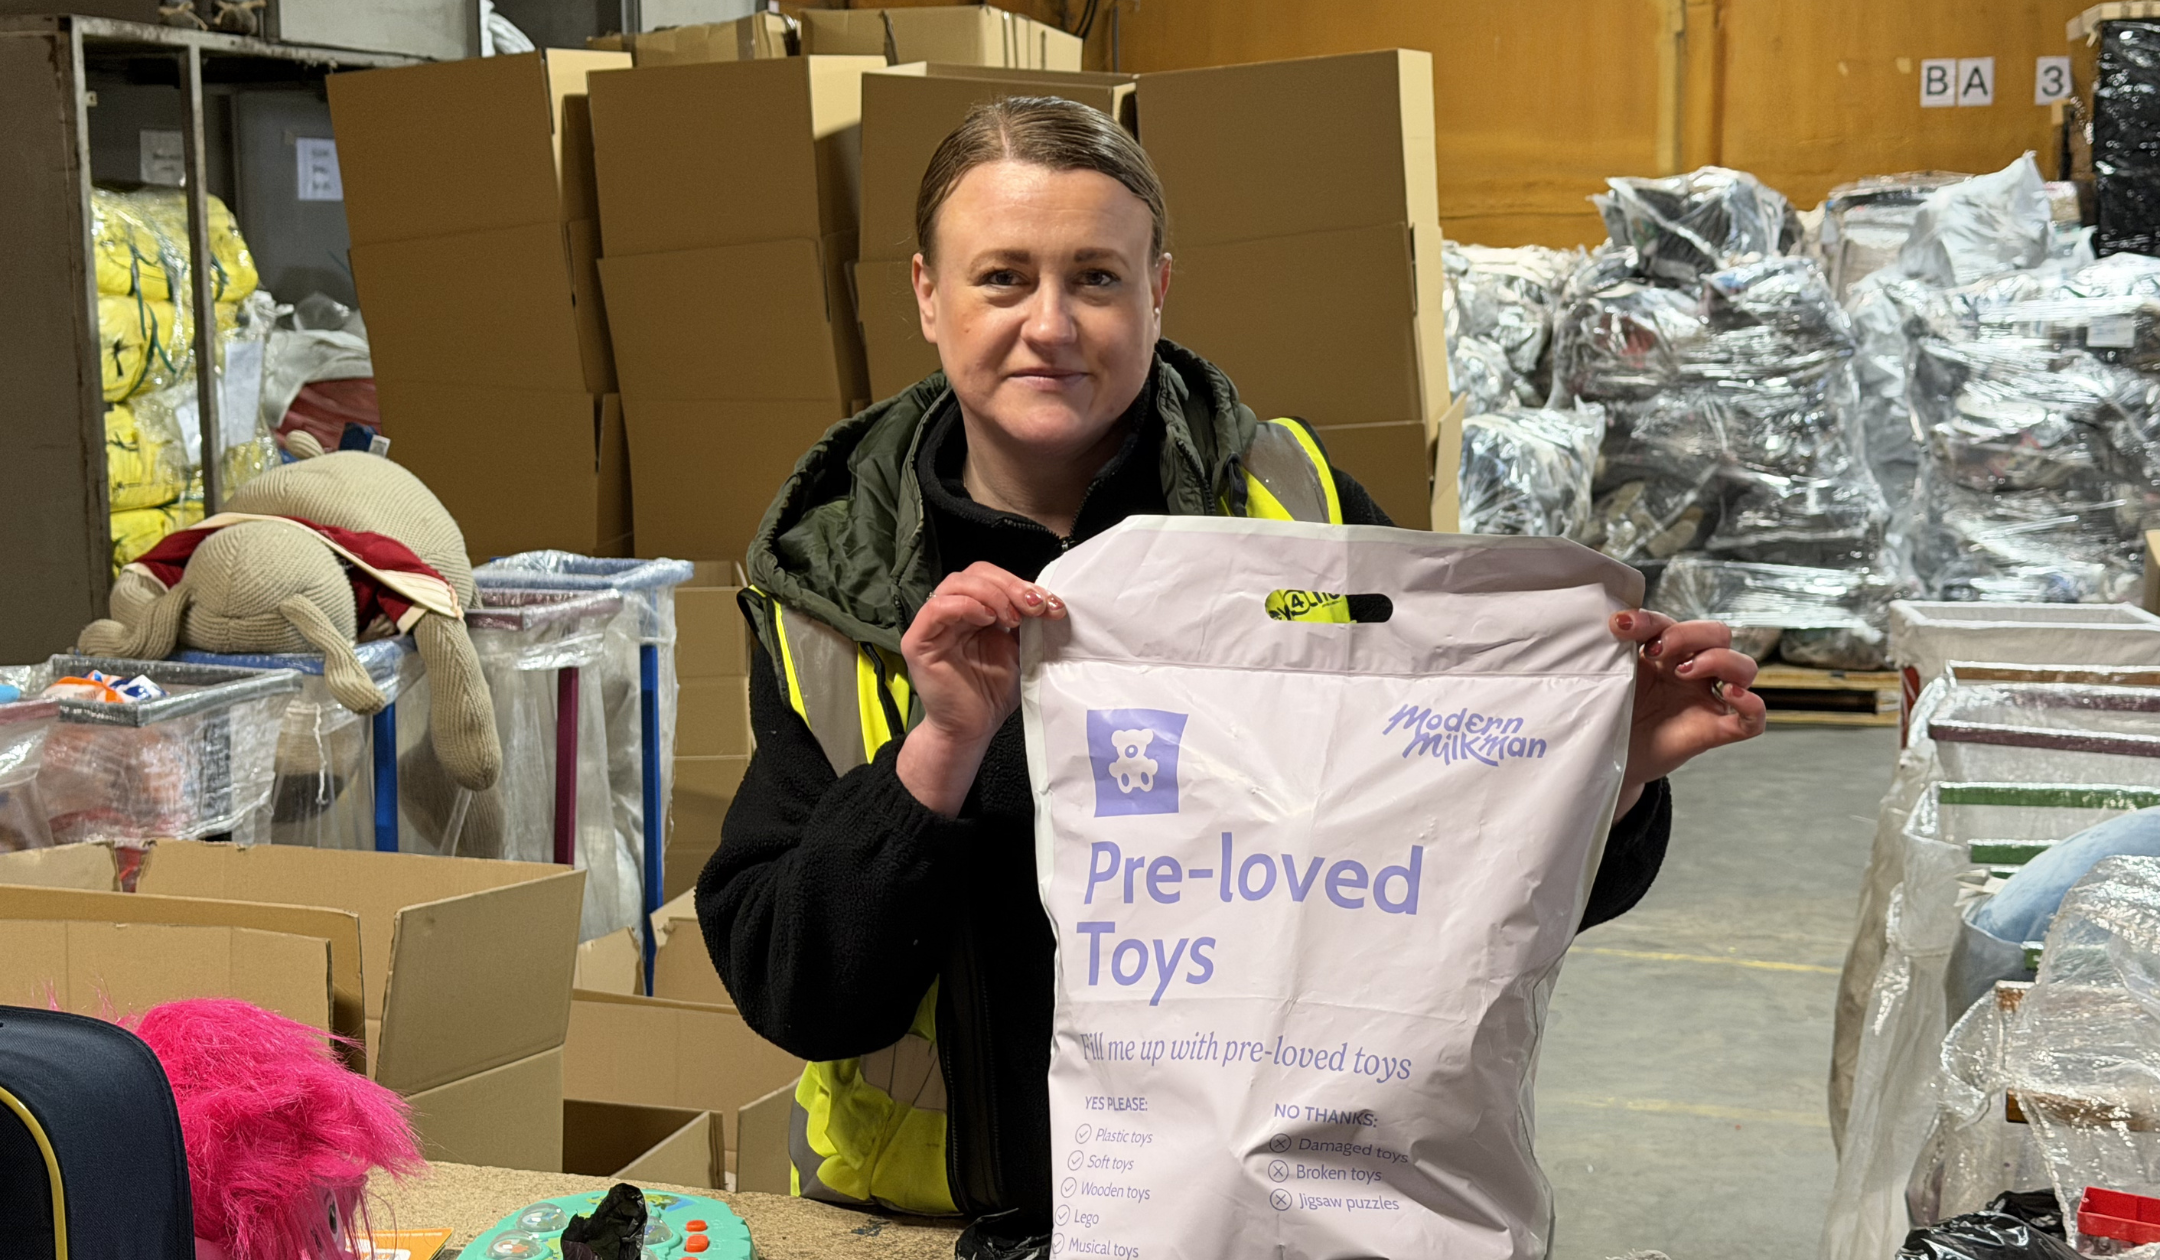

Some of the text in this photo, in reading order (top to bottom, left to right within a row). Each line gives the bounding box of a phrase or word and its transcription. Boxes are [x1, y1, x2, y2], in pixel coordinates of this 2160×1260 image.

[2041, 65, 2063, 97] 3
[1382, 703, 1524, 736] Modern
[1402, 731, 1547, 767] Milkman
[1084, 831, 1424, 915] Pre-loved
[1076, 921, 1216, 1007] Toys
[1080, 1031, 1412, 1083] Fill me up with pre-loved toys
[1085, 1096, 1148, 1112] YES PLEASE:
[1274, 1103, 1378, 1128] NO THANKS:
[1095, 1128, 1153, 1147] Plastic toys
[1298, 1138, 1409, 1164] Damaged toys
[1087, 1154, 1134, 1174] Soft toys
[1296, 1164, 1382, 1185] Broken toys
[1081, 1181, 1150, 1204] Wooden toys
[1299, 1193, 1400, 1212] Jigsaw puzzles
[1074, 1209, 1099, 1228] Lego
[1068, 1237, 1139, 1260] Musical toys
